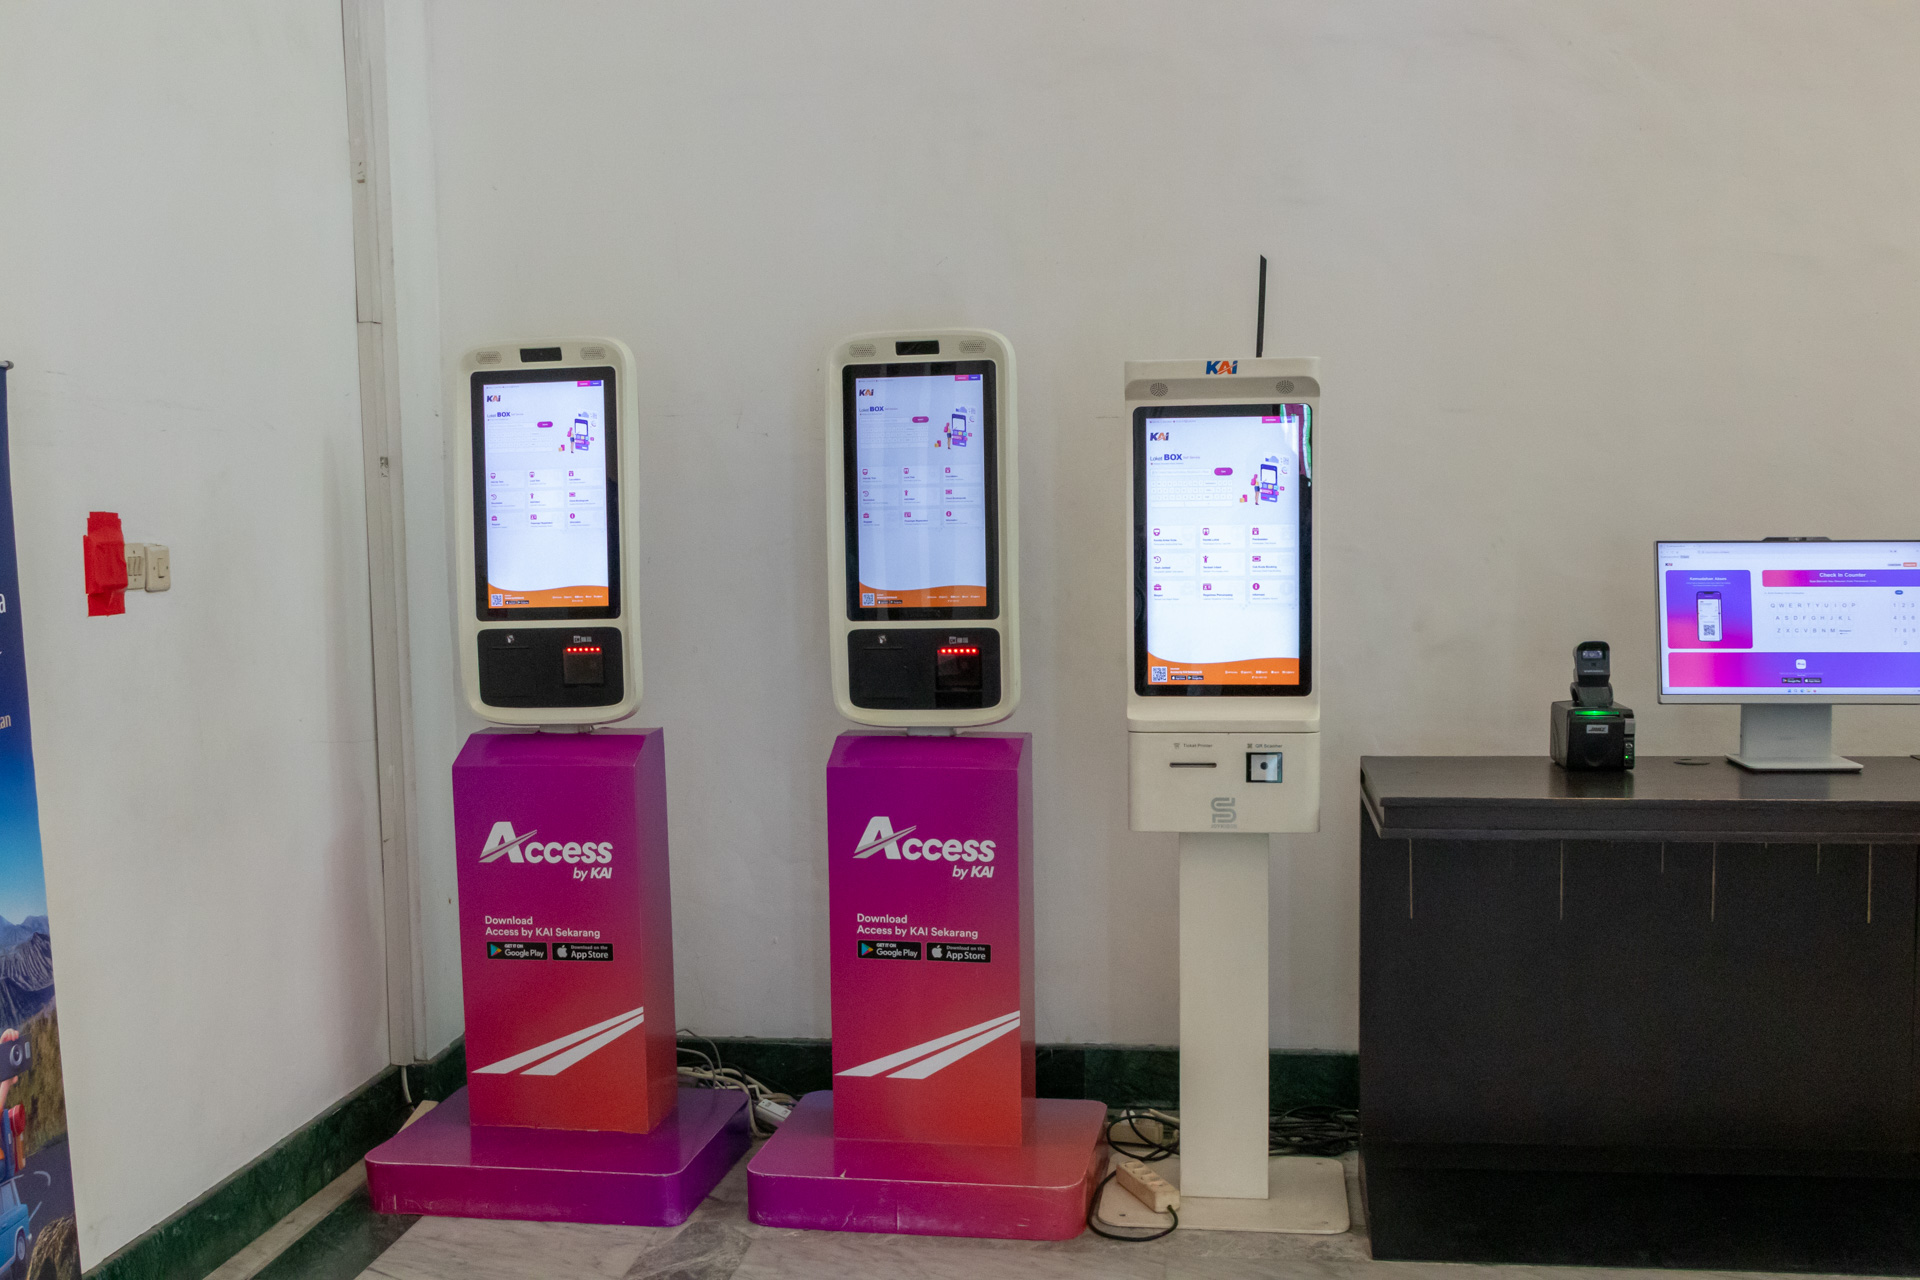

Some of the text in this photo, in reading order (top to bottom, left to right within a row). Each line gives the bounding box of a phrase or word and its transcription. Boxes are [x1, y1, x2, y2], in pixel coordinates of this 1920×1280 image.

[479, 821, 613, 864] Access
[853, 816, 996, 862] Access
[573, 867, 612, 881] by KAI
[952, 865, 994, 880] by KAI
[485, 916, 533, 925] Download
[857, 913, 907, 924] Download
[485, 927, 600, 939] Access by KAI Sekarang
[857, 925, 978, 939] Access by KAI Sekarang
[504, 949, 544, 958] Google Play
[571, 951, 587, 959] App
[876, 948, 918, 958] Google Play
[946, 951, 963, 960] App
